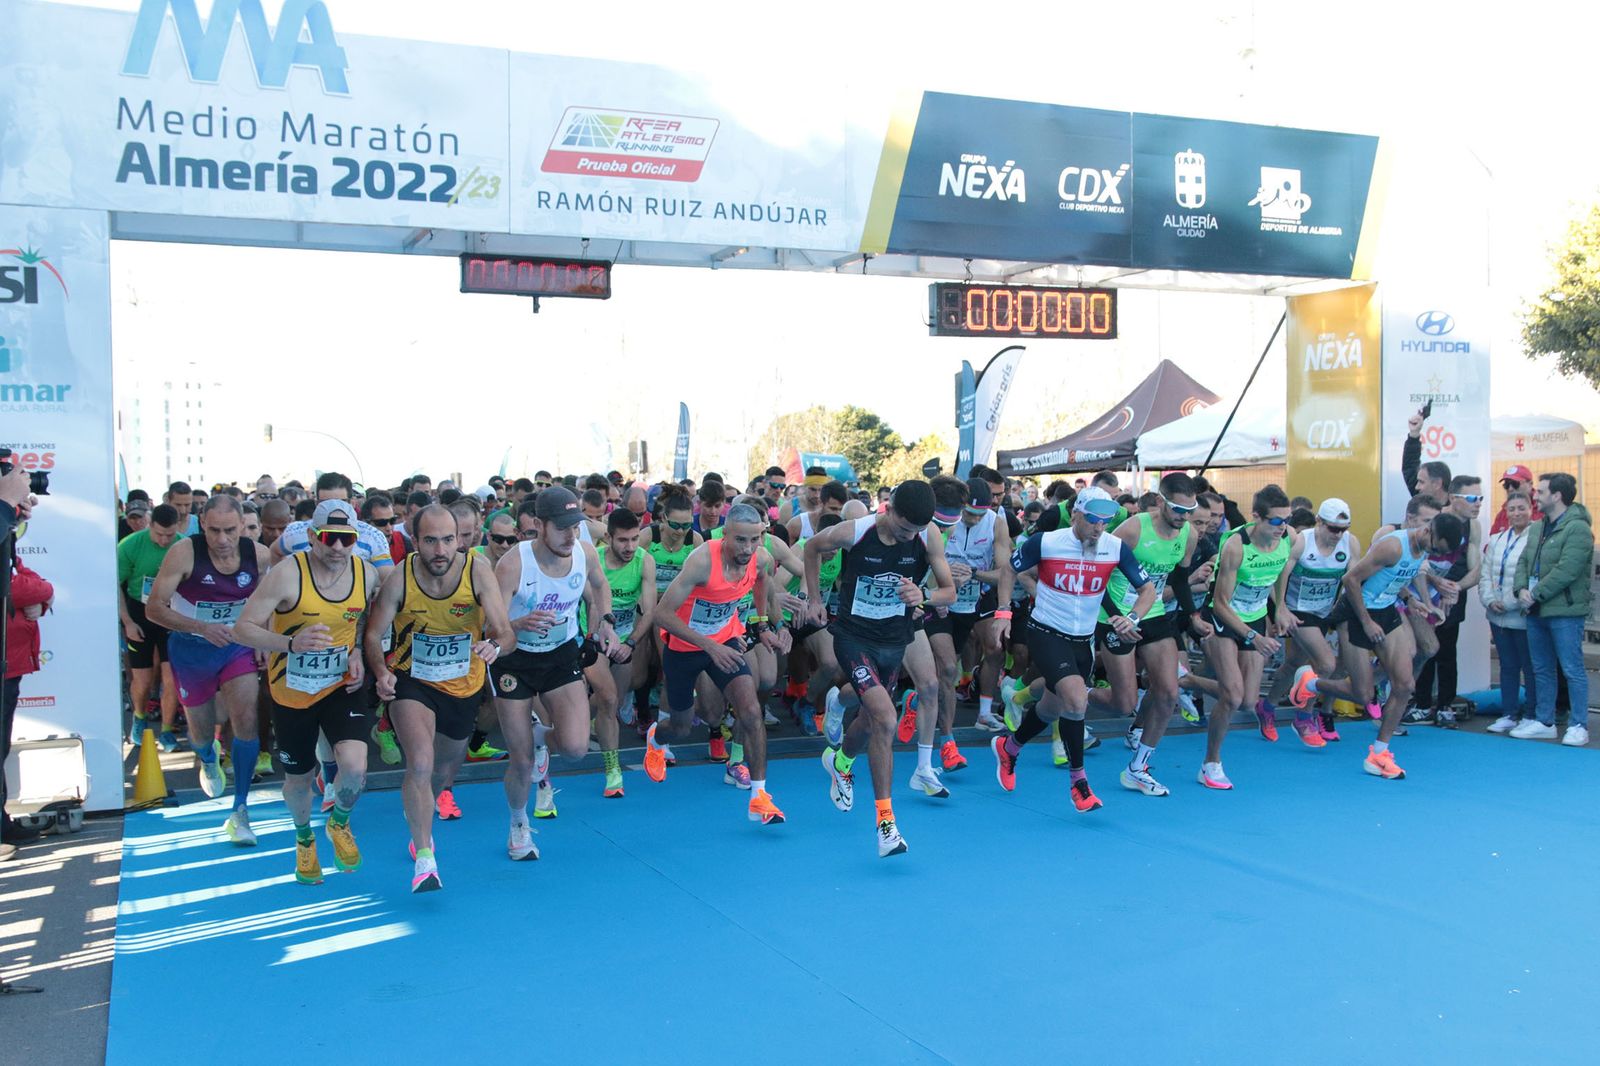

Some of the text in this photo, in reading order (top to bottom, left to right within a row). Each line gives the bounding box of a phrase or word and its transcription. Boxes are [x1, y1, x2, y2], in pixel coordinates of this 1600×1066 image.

[116, 97, 459, 156] Medio Maratón
[627, 117, 682, 132] RFEA
[620, 130, 705, 146] ATLETISMO
[615, 141, 674, 154] RUNNING
[577, 157, 677, 176] Prueba Oficial
[960, 153, 987, 165] GRUPO
[116, 142, 318, 195] Almería
[938, 160, 1026, 203] NEXA
[1057, 163, 1130, 204] CDX
[537, 190, 828, 226] RAMÓN RUIZ ANDÚJAR
[1059, 202, 1125, 214] CLUB DEPORTIVO NEXA
[1163, 214, 1218, 230] ALMERÍA
[1260, 222, 1297, 234] DEPORTES
[1298, 225, 1309, 234] DE
[1176, 228, 1206, 238] CIUDAD
[1303, 332, 1363, 372] NEXA
[1401, 340, 1470, 353] HYUNDAI
[1409, 394, 1460, 403] ESTRELLA
[1307, 411, 1358, 449] CDX
[1054, 572, 1084, 592] KM
[543, 593, 559, 602] GO
[212, 607, 232, 619] 82
[424, 642, 459, 657] 705
[296, 653, 341, 669] 1411
